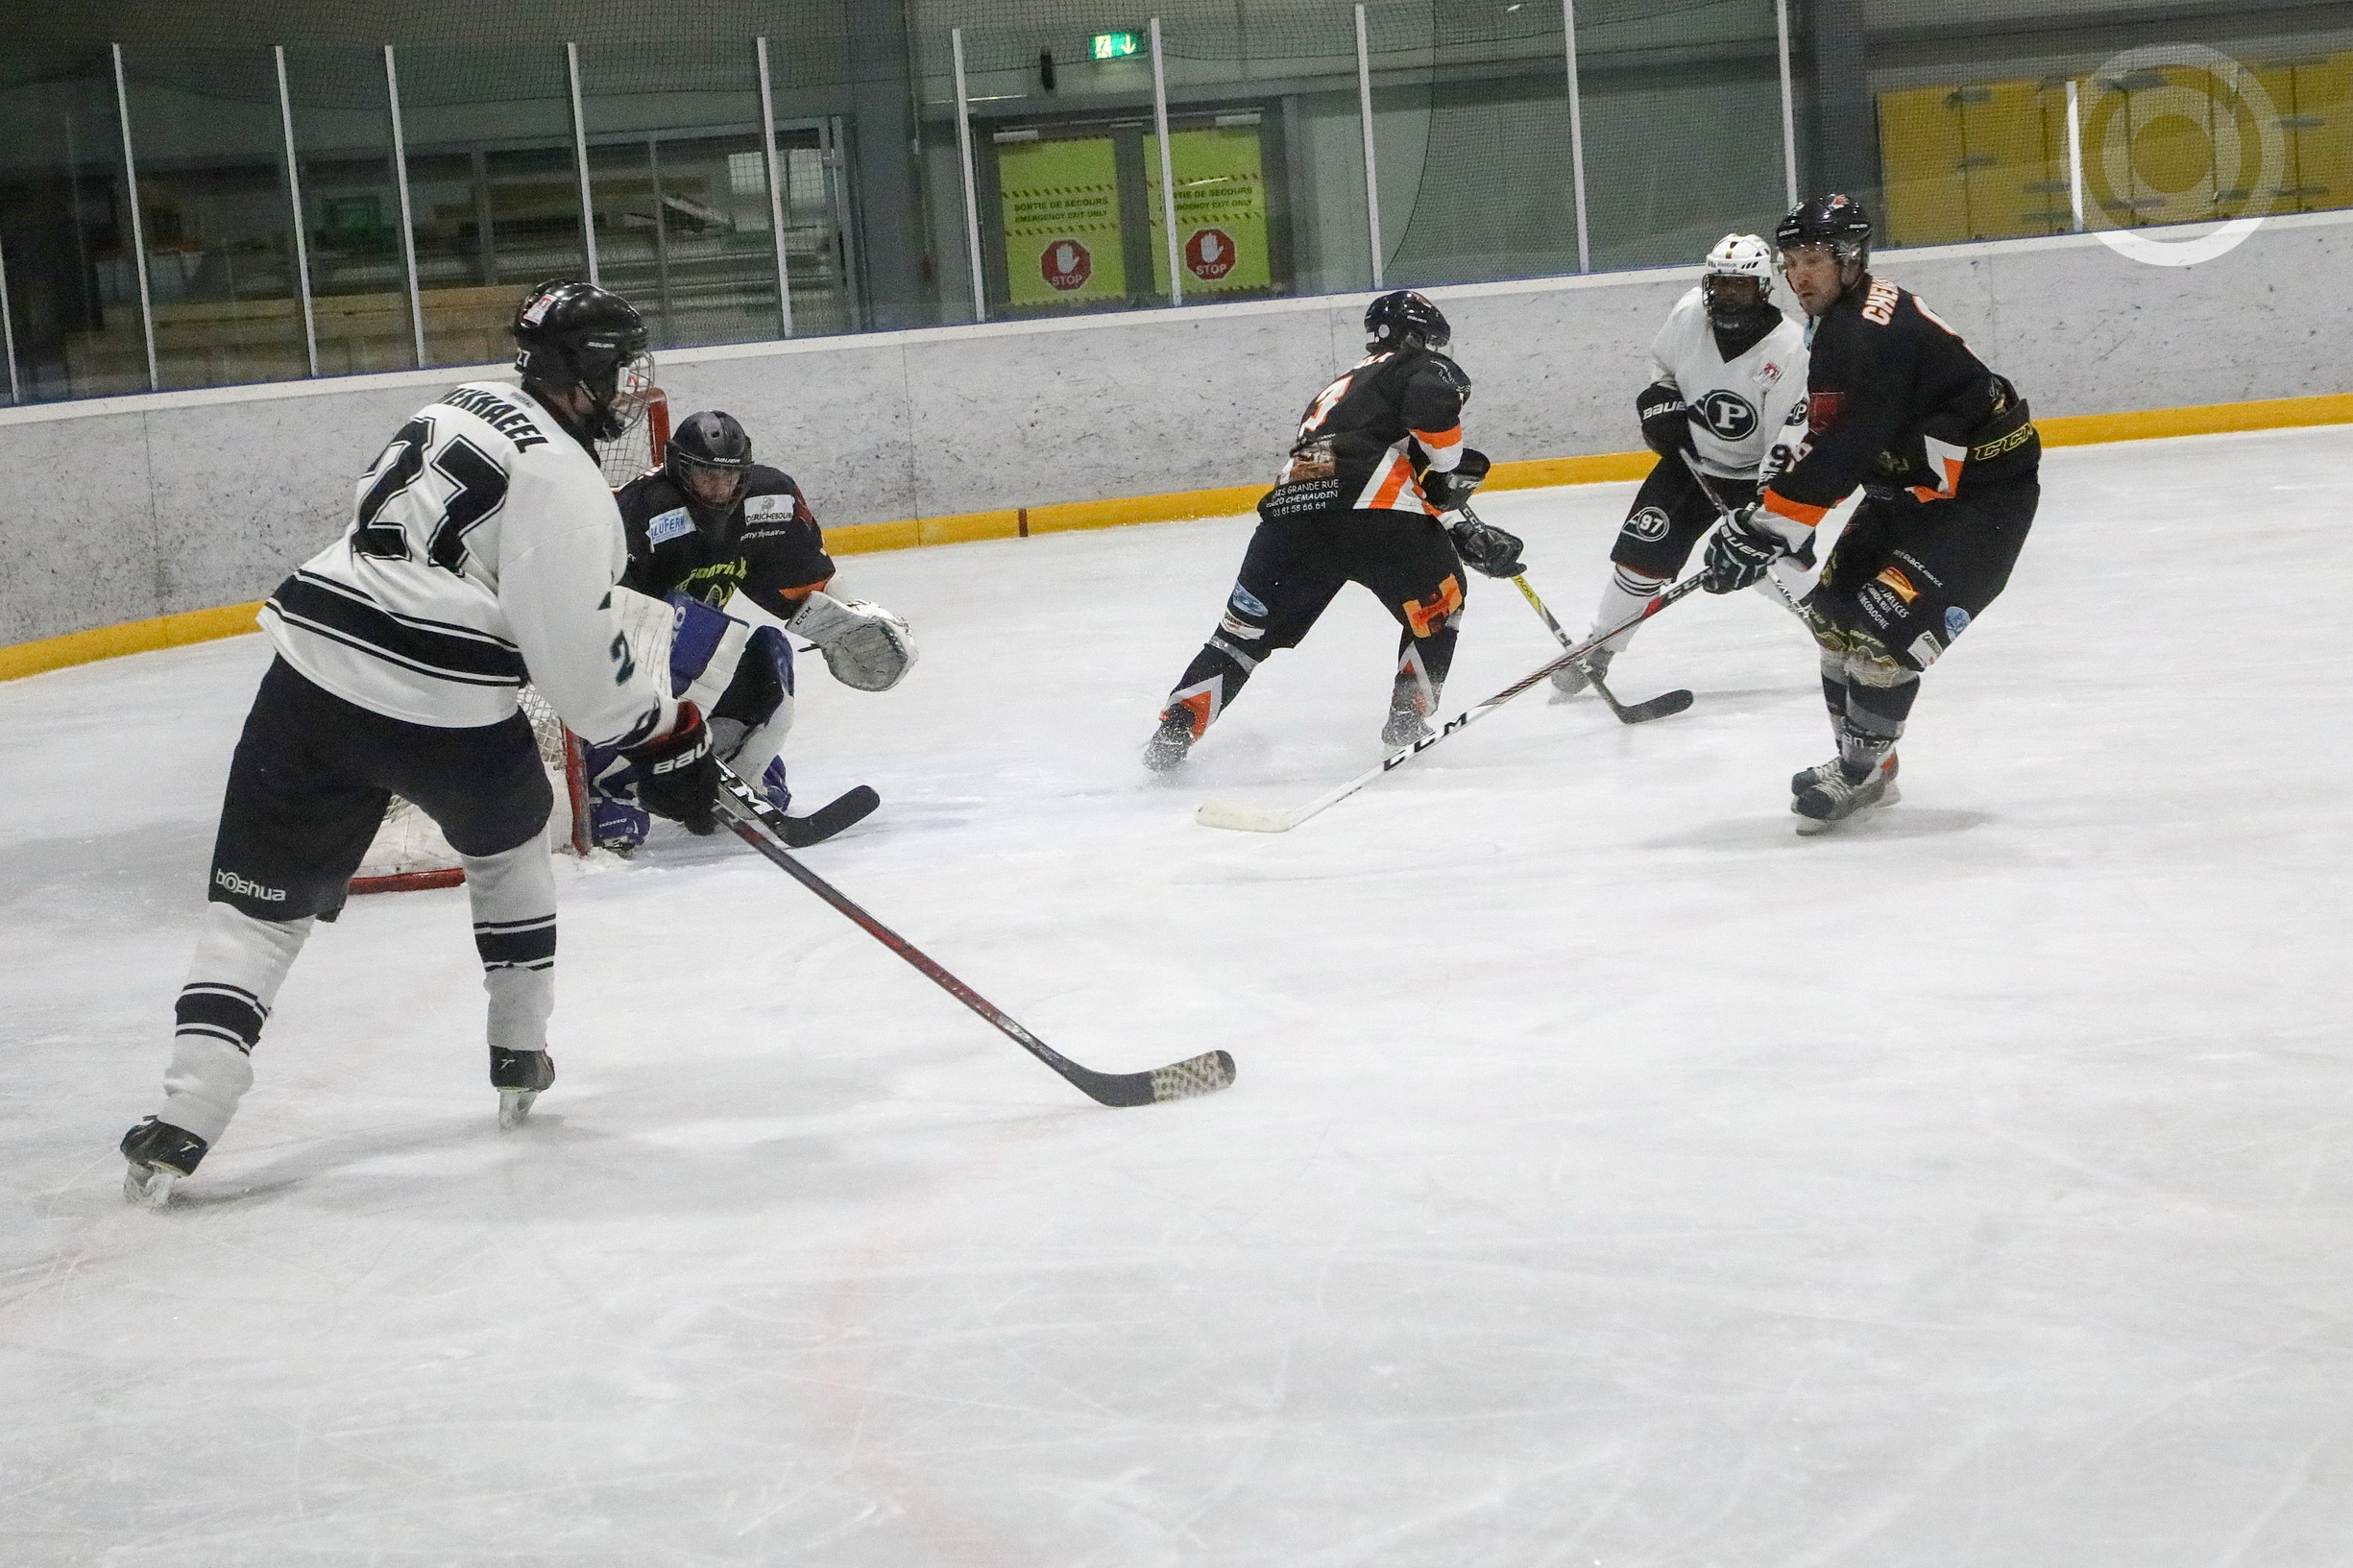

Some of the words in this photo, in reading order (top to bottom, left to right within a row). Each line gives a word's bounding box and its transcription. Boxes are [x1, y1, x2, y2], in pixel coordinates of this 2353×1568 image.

[1194, 190, 1207, 199] DE
[1209, 186, 1253, 197] SECOURS
[1014, 202, 1047, 212] SORTIE
[1050, 200, 1062, 209] DE
[1064, 197, 1108, 207] SECOURS
[1212, 200, 1230, 209] EXIT
[1231, 198, 1252, 207] ONLY
[1014, 212, 1066, 223] EMERGENCY
[1068, 210, 1084, 220] EXIT
[1087, 209, 1108, 219] ONLY
[1195, 263, 1227, 276] STOP
[1052, 274, 1083, 286] STOP
[516, 347, 532, 368] 27
[1714, 400, 1749, 430] P
[713, 456, 741, 465] BAUER
[1287, 480, 1320, 495] GRANDE
[1322, 478, 1340, 490] RUE
[350, 415, 510, 578] 27
[1285, 490, 1339, 504] CHEMAUDIN
[1273, 507, 1281, 517] 03
[1281, 505, 1290, 516] 81
[1291, 504, 1301, 514] 58
[1315, 500, 1326, 510] 64
[745, 512, 793, 523] DERICHEBOUR
[1462, 507, 1486, 534] CCM
[1638, 514, 1665, 535] 97
[1516, 576, 1535, 599] TACKS
[1879, 599, 1893, 614] RUE
[1882, 591, 1910, 618] DELICES
[794, 606, 813, 626] CCM
[1383, 712, 1467, 772] CCM
[214, 867, 287, 903] boshua
